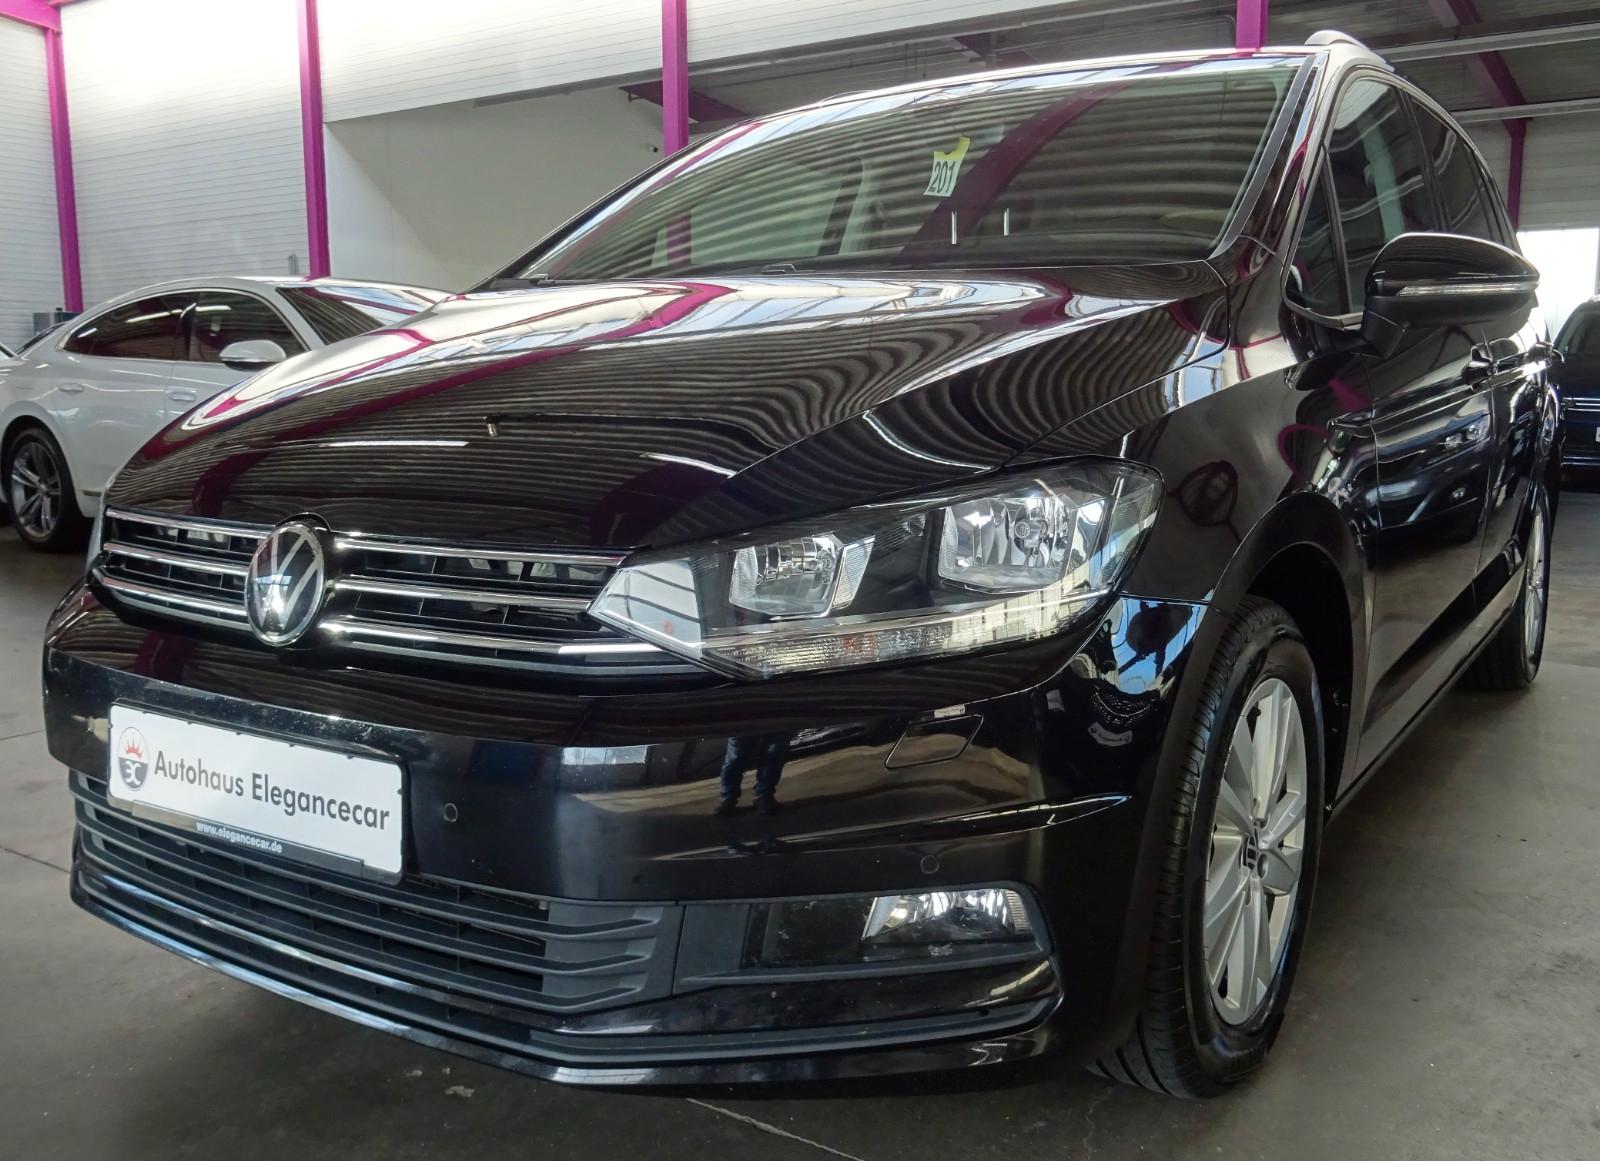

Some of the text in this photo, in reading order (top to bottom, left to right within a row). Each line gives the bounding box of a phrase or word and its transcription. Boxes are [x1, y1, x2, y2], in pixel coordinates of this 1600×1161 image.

[927, 160, 956, 194] 201
[154, 750, 390, 830] Autohaus Elegancecar
[196, 822, 283, 853] www.elegancecar.de
